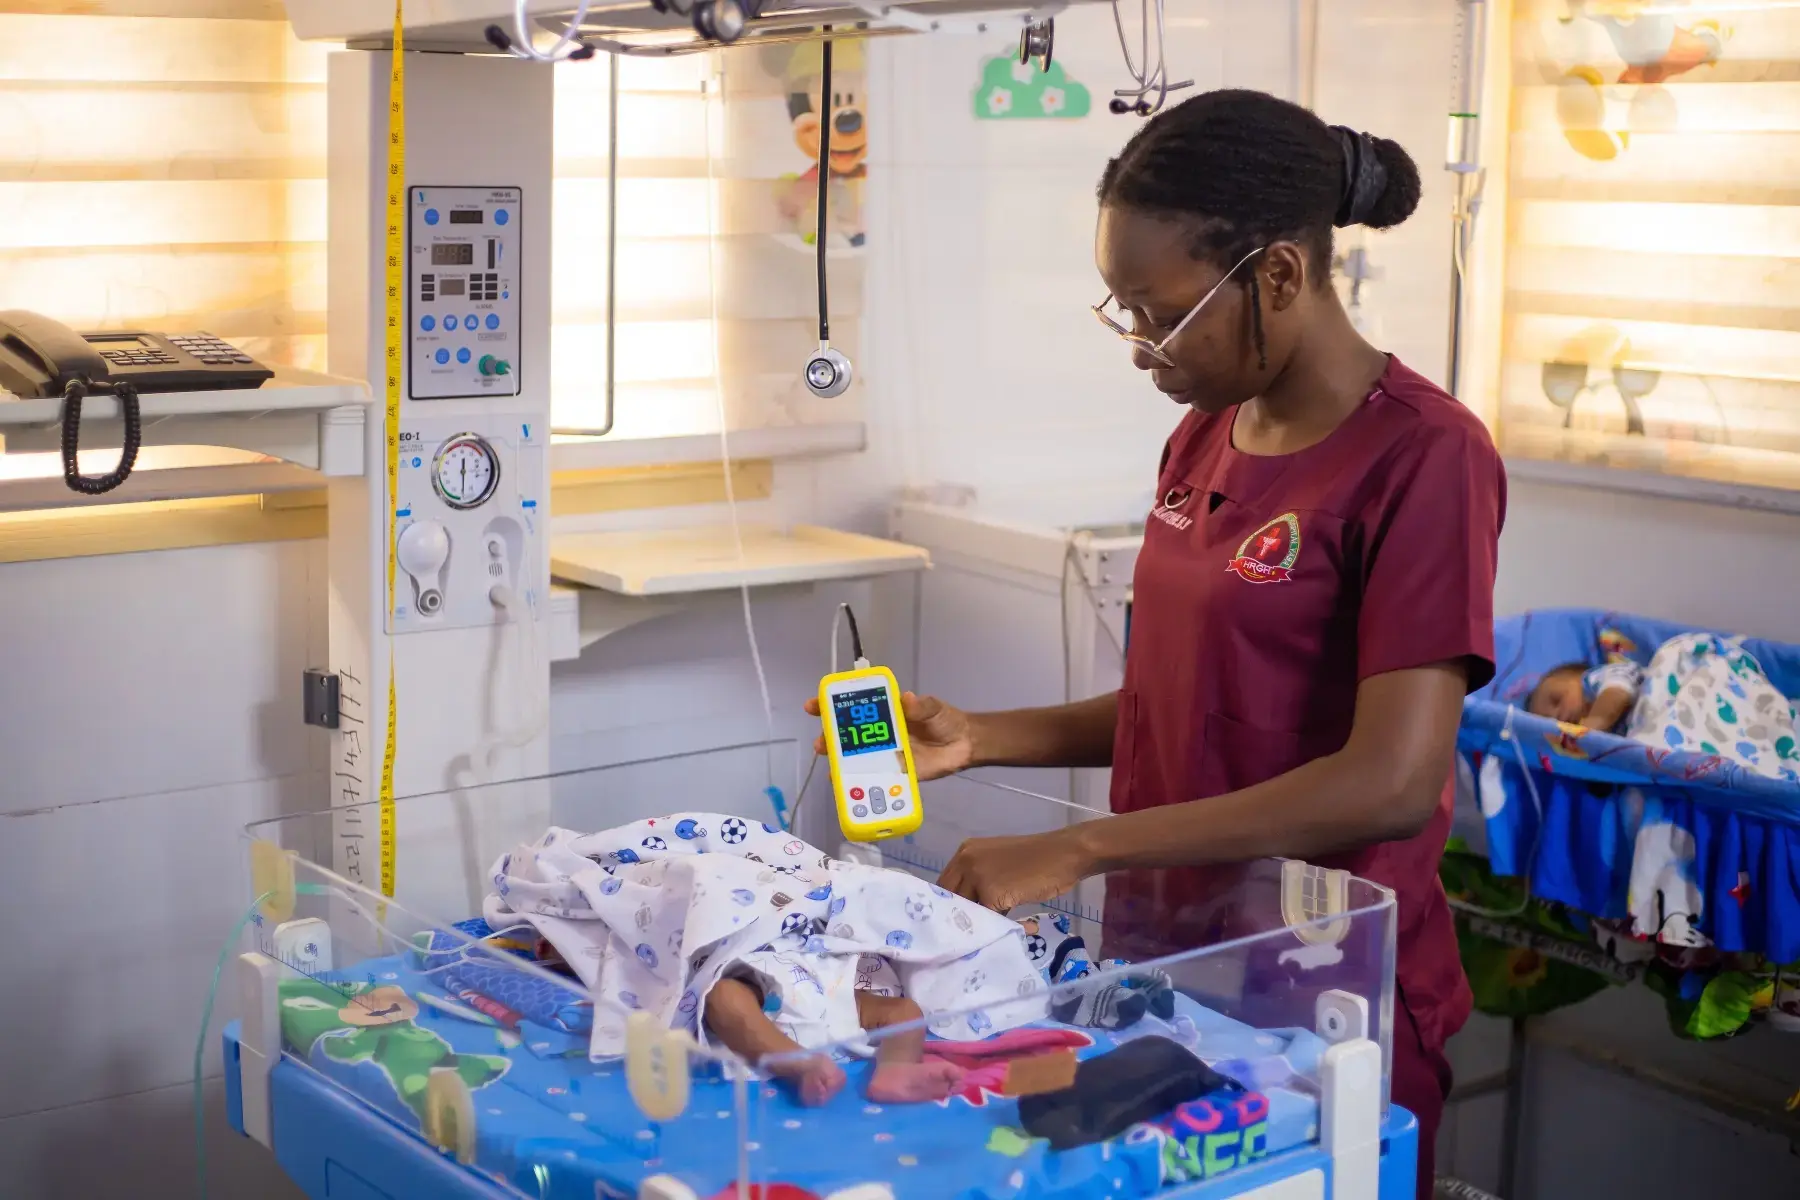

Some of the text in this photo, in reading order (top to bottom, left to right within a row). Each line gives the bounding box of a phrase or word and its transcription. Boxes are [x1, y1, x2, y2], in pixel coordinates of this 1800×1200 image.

[392, 102, 399, 113] 27
[392, 133, 399, 144] 28
[391, 163, 398, 174] 29
[389, 225, 397, 235] 31
[388, 255, 396, 266] 32
[388, 286, 396, 296] 33
[388, 316, 396, 327] 34
[388, 346, 396, 357] 35
[388, 376, 395, 387] 36
[387, 406, 394, 417] 37
[399, 432, 420, 441] EO-I
[1243, 560, 1272, 575] HRGH
[850, 703, 879, 725] 99
[847, 721, 889, 745] 129
